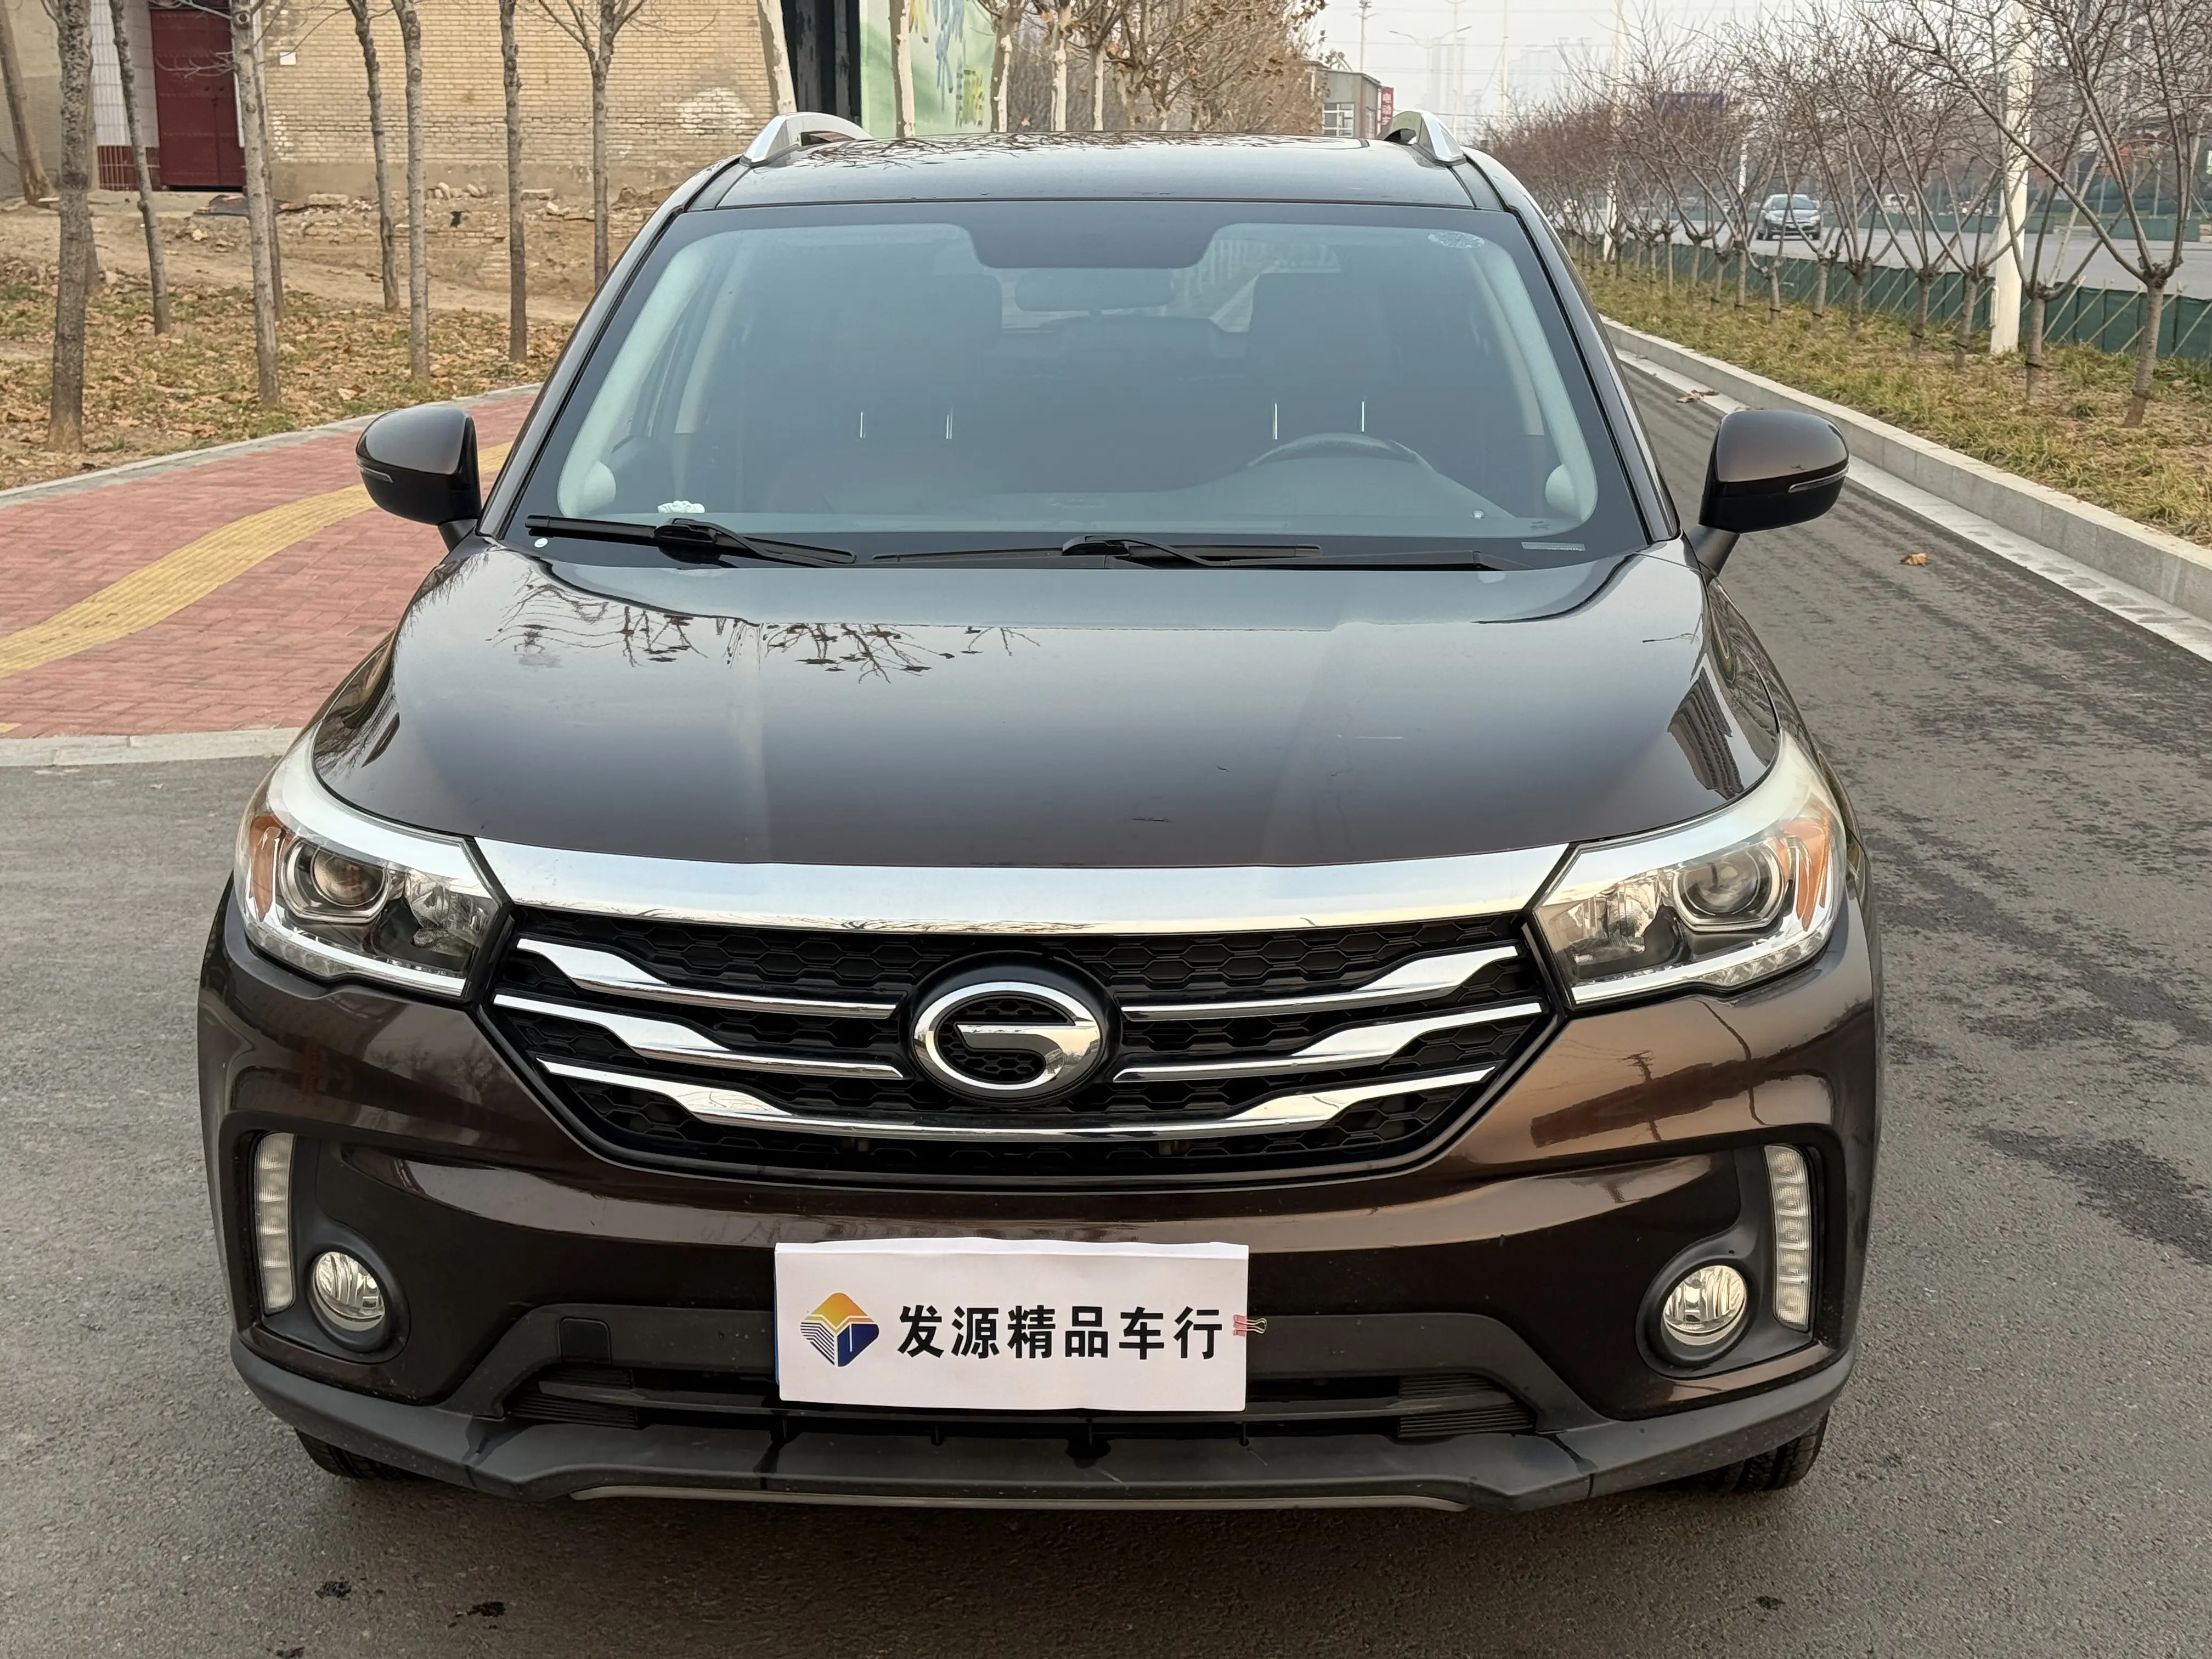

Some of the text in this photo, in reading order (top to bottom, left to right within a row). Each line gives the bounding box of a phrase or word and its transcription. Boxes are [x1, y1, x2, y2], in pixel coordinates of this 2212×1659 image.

[898, 1305, 1222, 1360] 发源精品车行
